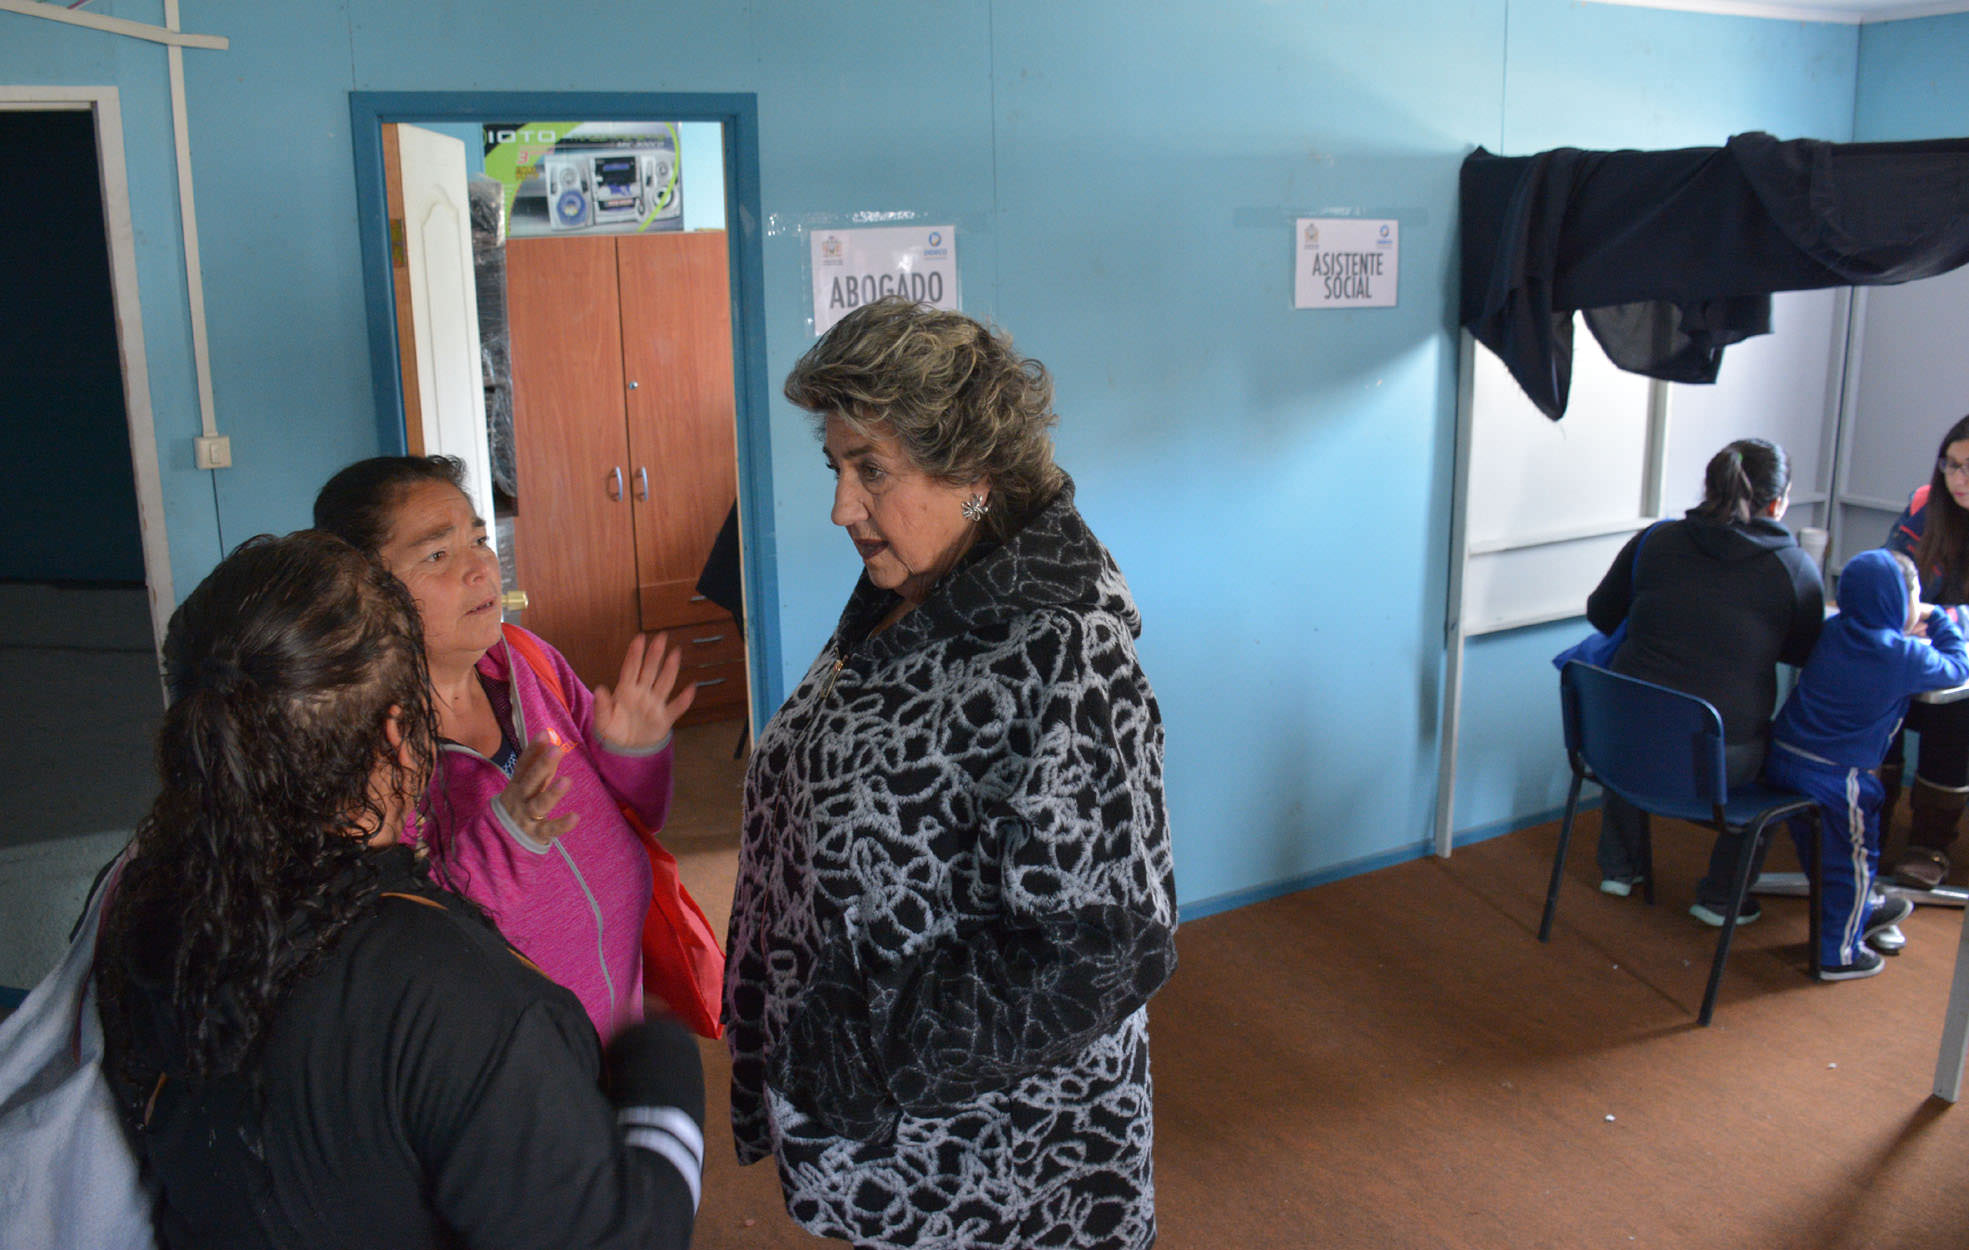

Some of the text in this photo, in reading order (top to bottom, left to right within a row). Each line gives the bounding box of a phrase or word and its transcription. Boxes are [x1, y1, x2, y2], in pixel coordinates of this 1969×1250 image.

[1312, 252, 1384, 276] ASISTENTE
[830, 271, 943, 309] ABOGADO
[1324, 276, 1373, 299] SOCIAL
